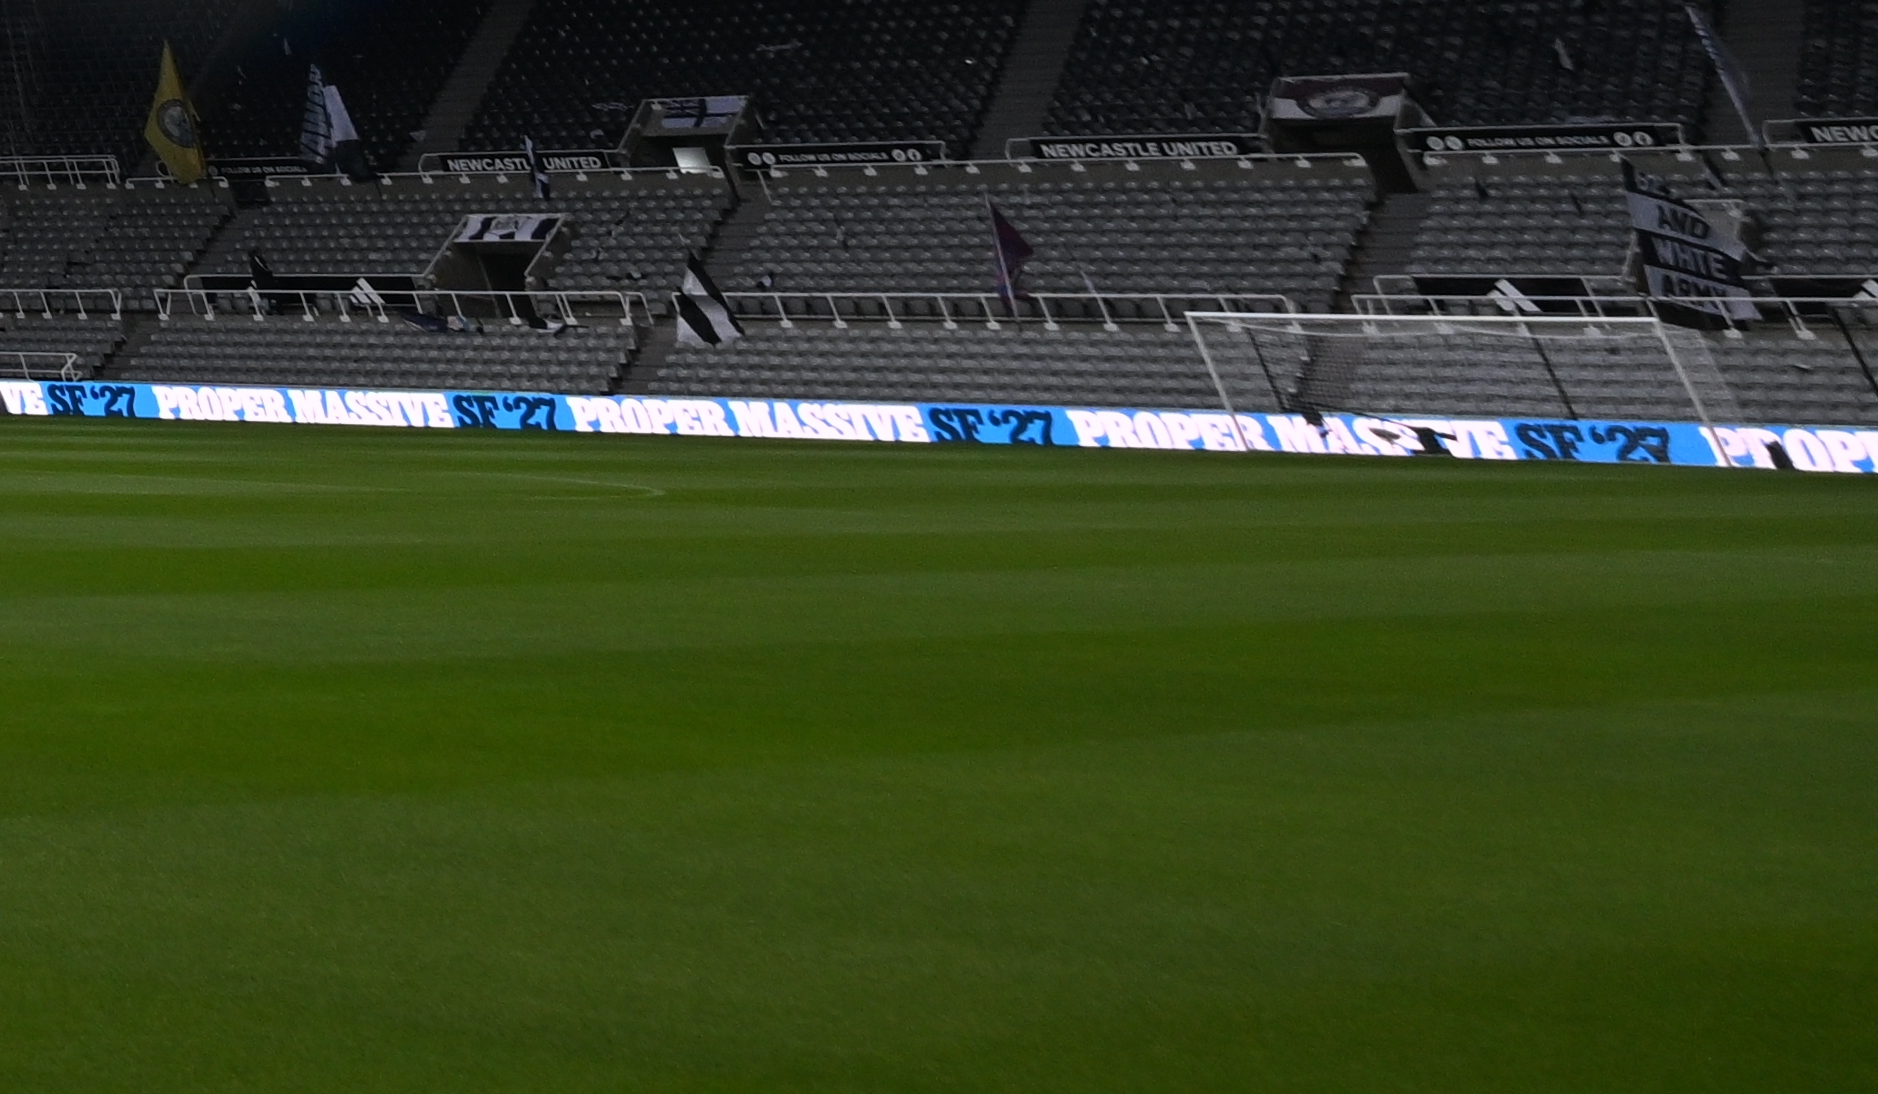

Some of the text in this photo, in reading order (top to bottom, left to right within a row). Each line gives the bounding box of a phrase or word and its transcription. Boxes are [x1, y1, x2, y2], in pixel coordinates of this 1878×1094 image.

[1039, 141, 1238, 157] NEWCASTLE UNITED
[1466, 135, 1611, 147] FOLLOW US ON SOCIALS
[447, 154, 603, 172] NEWCASTL UNITED
[778, 151, 890, 163] FOLLOW US ON SOCIALS
[47, 384, 86, 416] SF
[152, 385, 292, 422] PROPER
[295, 389, 454, 428] MASSIVE
[456, 395, 496, 429] SF
[568, 397, 740, 437] PROPER
[743, 403, 931, 442] MASSIVE
[931, 407, 984, 444] SF
[1067, 409, 1265, 452] PROPER
[1515, 422, 1581, 461] SF
